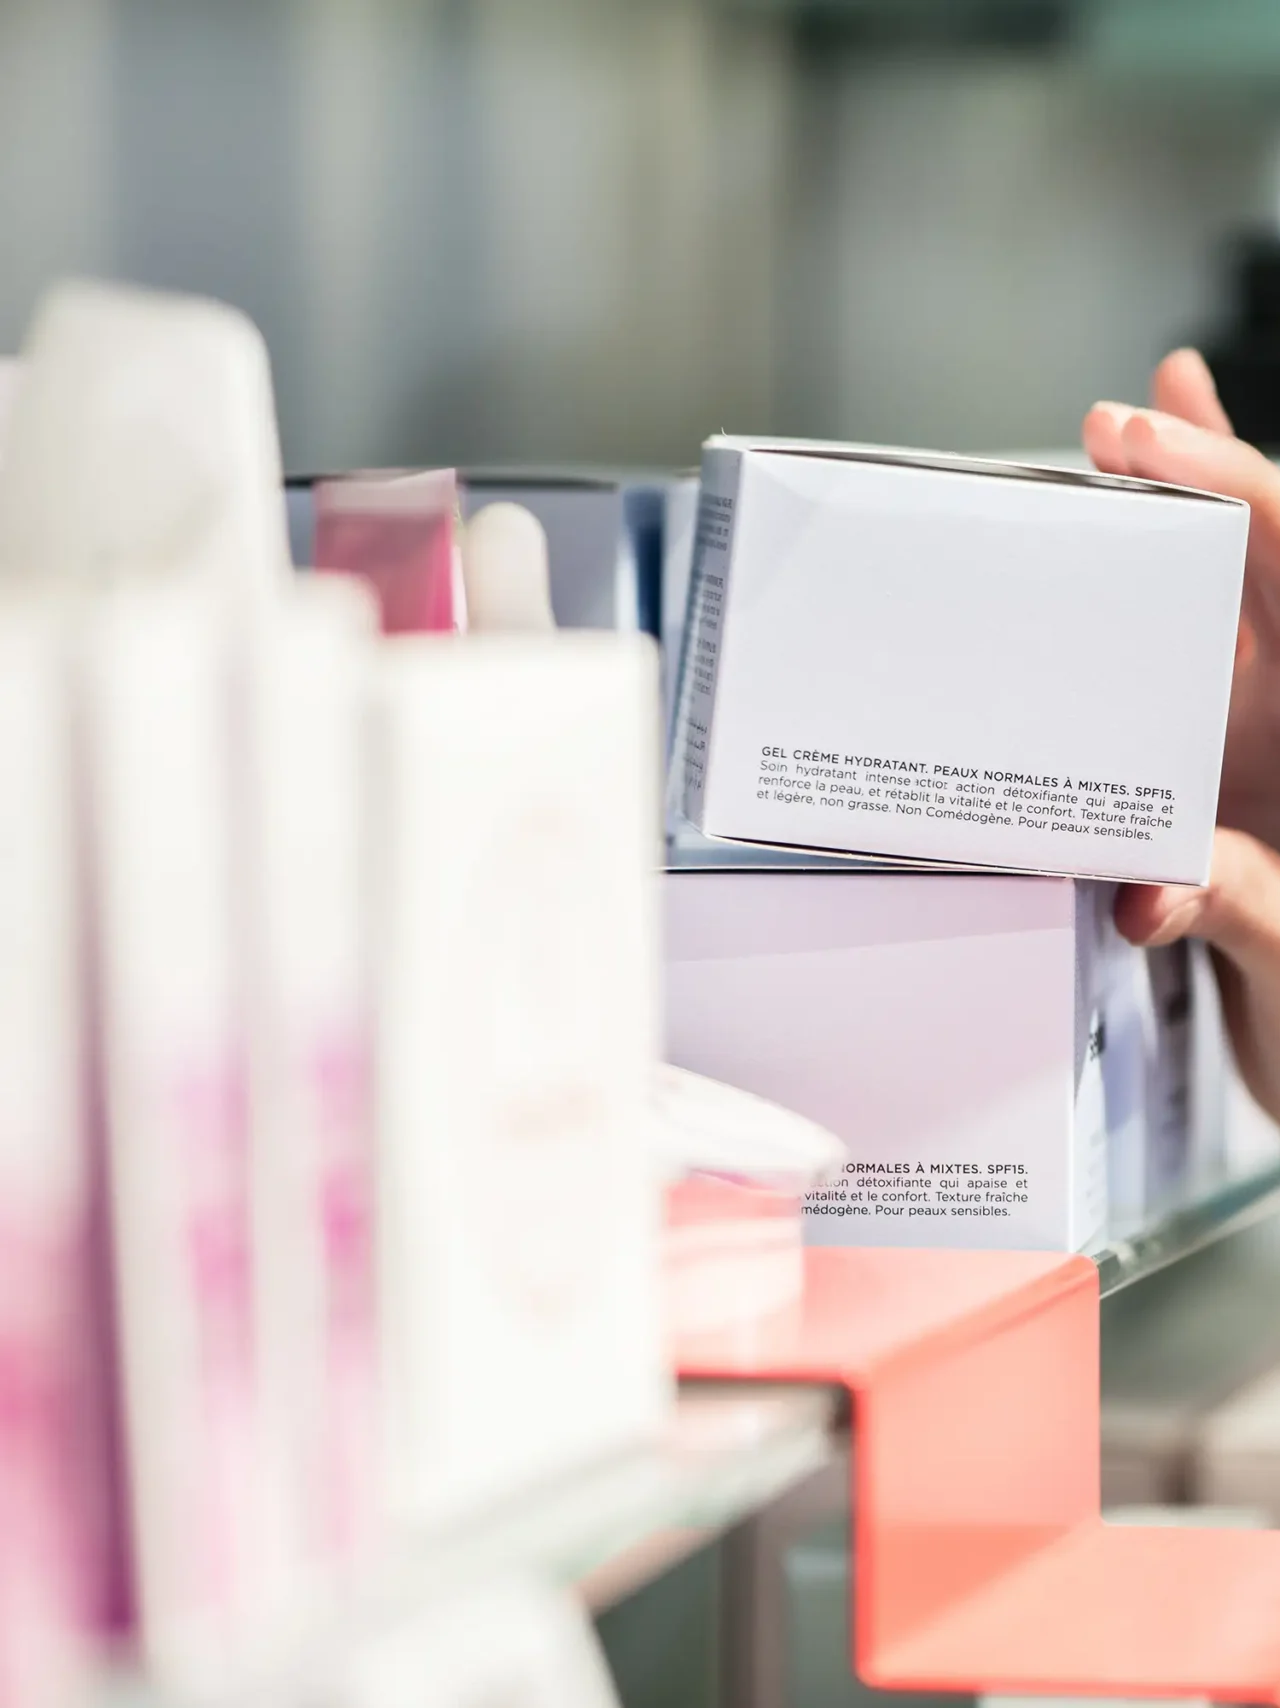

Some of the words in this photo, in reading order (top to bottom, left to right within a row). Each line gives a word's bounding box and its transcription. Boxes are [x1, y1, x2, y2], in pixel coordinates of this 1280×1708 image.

[760, 760, 788, 773] Soin
[796, 764, 857, 781] hydratant
[865, 771, 911, 787] intense
[955, 783, 995, 795] action
[1003, 786, 1078, 804] détoxifiante
[1085, 796, 1106, 808] qui
[1113, 799, 1154, 813] apaise
[1161, 804, 1175, 815] et
[761, 746, 788, 759] GEL
[793, 749, 840, 765] CRÈME
[844, 755, 928, 774] HYDRATANT.
[933, 764, 979, 780] PEAUX
[983, 770, 1059, 788] NORMALES
[1063, 776, 1073, 790] À
[1078, 780, 1130, 796] MIXTES.
[1134, 786, 1175, 801] SPF15.
[757, 789, 769, 800] et
[773, 790, 815, 805] légère,
[820, 797, 844, 807] non
[847, 799, 891, 812] grasse.
[895, 803, 922, 816] Non
[925, 806, 1014, 826] Comédogène.
[1018, 816, 1048, 829] Pour
[1051, 822, 1090, 834] peaux
[1093, 826, 1153, 841] sensibles.
[758, 776, 812, 790] renforce
[815, 780, 826, 791] la
[829, 783, 864, 797] peau,
[868, 787, 881, 797] et
[885, 788, 931, 803] rétablit
[934, 792, 945, 804] la
[949, 794, 992, 809] vitalité
[995, 801, 1008, 811] et
[1012, 801, 1023, 813] le
[1026, 804, 1076, 818] confort.
[1080, 808, 1126, 824] Texture
[1130, 813, 1173, 829] fraîche
[841, 1163, 911, 1174] ORMALES
[915, 1161, 925, 1174] À
[930, 1163, 982, 1175] MIXTES.
[987, 1164, 1028, 1175] SPF15.
[856, 1176, 932, 1188] détoxifiante
[939, 1177, 959, 1190] qui
[967, 1178, 1008, 1191] apaise
[1015, 1178, 1028, 1189] et
[801, 1203, 871, 1217] médogène.
[875, 1204, 905, 1216] Pour
[908, 1207, 947, 1218] peaux
[950, 1205, 1011, 1217] sensibles.
[804, 1190, 847, 1202] vitalité
[850, 1191, 863, 1202] et
[867, 1190, 878, 1202] le
[881, 1190, 931, 1202] confort.
[935, 1191, 982, 1203] Texture
[985, 1191, 1028, 1203] fraîche
